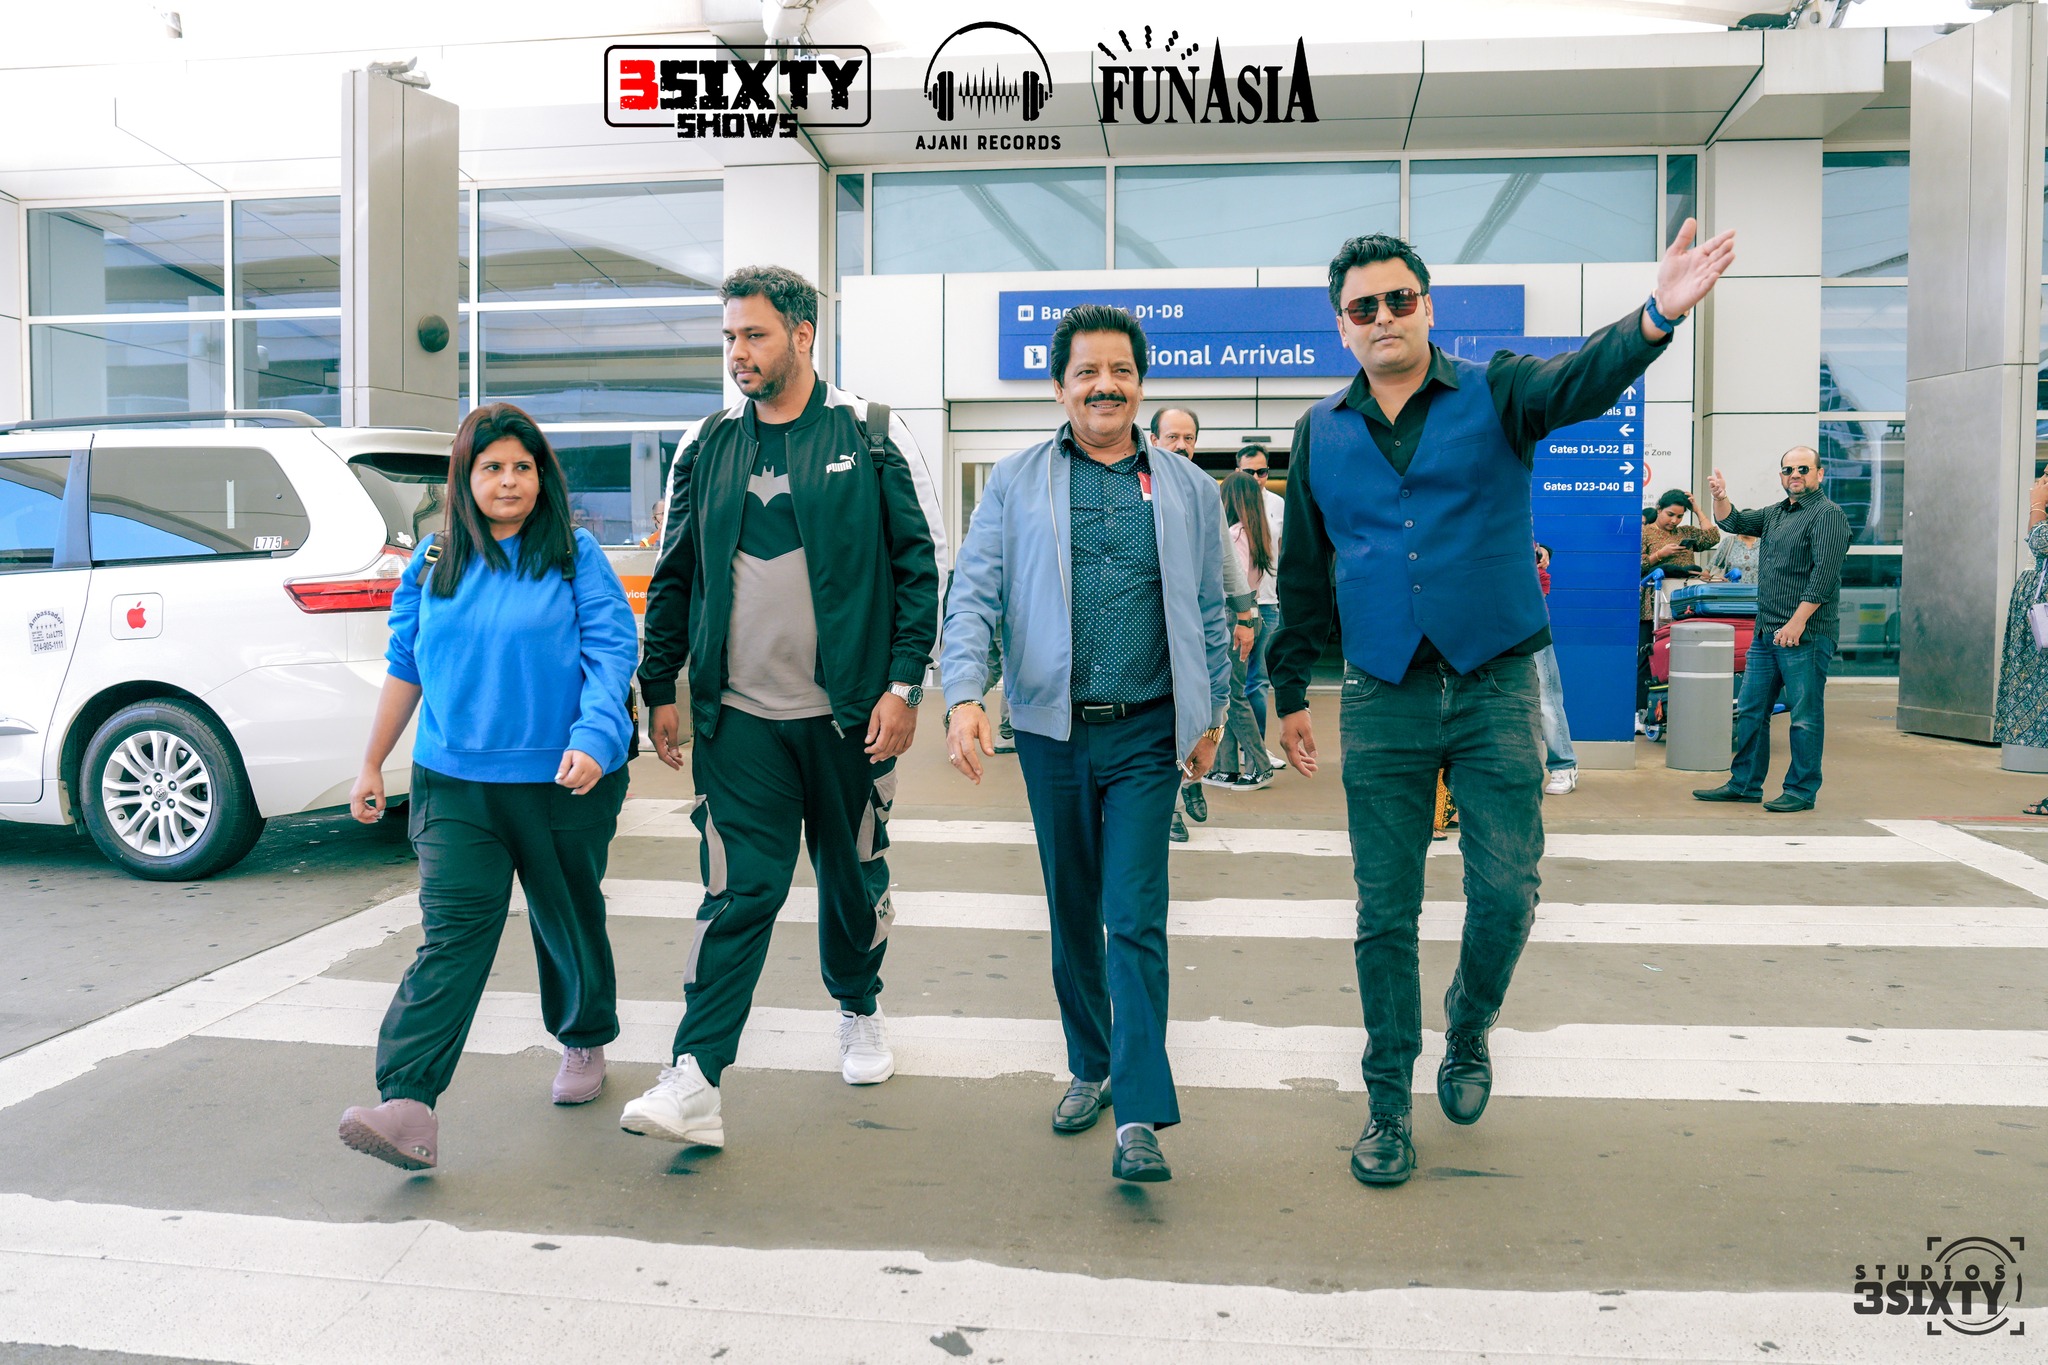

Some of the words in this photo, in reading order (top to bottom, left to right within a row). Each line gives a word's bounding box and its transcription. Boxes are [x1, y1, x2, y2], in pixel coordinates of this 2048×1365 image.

[1135, 304, 1184, 319] D1-D8
[1220, 344, 1315, 365] Arrivals
[1549, 444, 1578, 454] Gates
[1581, 444, 1619, 454] D1-D22
[826, 460, 852, 473] PUMA
[1543, 481, 1572, 491] Gates
[1575, 481, 1619, 491] D23-D40
[255, 537, 280, 549] L775
[29, 610, 63, 629] Ambassador
